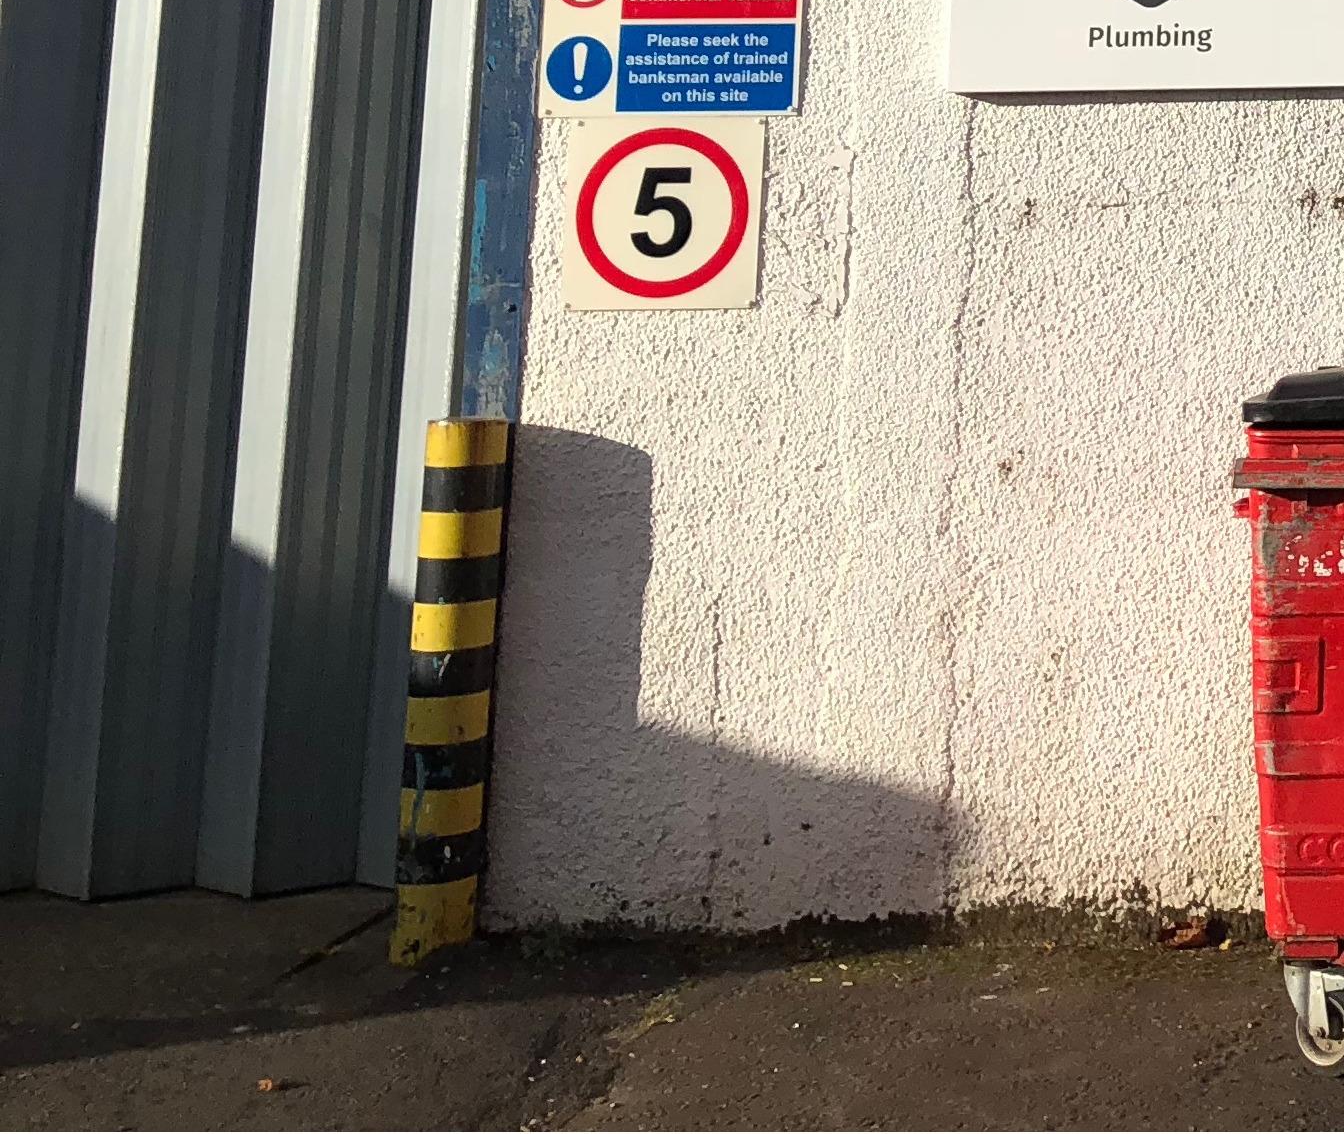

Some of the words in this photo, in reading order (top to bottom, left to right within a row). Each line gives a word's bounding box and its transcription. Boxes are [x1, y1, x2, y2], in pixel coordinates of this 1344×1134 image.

[646, 32, 699, 48] Please
[702, 32, 740, 47] seek
[743, 32, 769, 47] the
[1087, 22, 1214, 53] Plumbing
[625, 51, 711, 67] assistance
[713, 51, 731, 66] of
[733, 50, 789, 65] trained
[628, 70, 710, 85] banksman
[713, 69, 784, 84] available
[661, 91, 683, 103] on
[685, 88, 717, 103] this
[719, 88, 749, 102] site
[630, 166, 693, 259] 5
